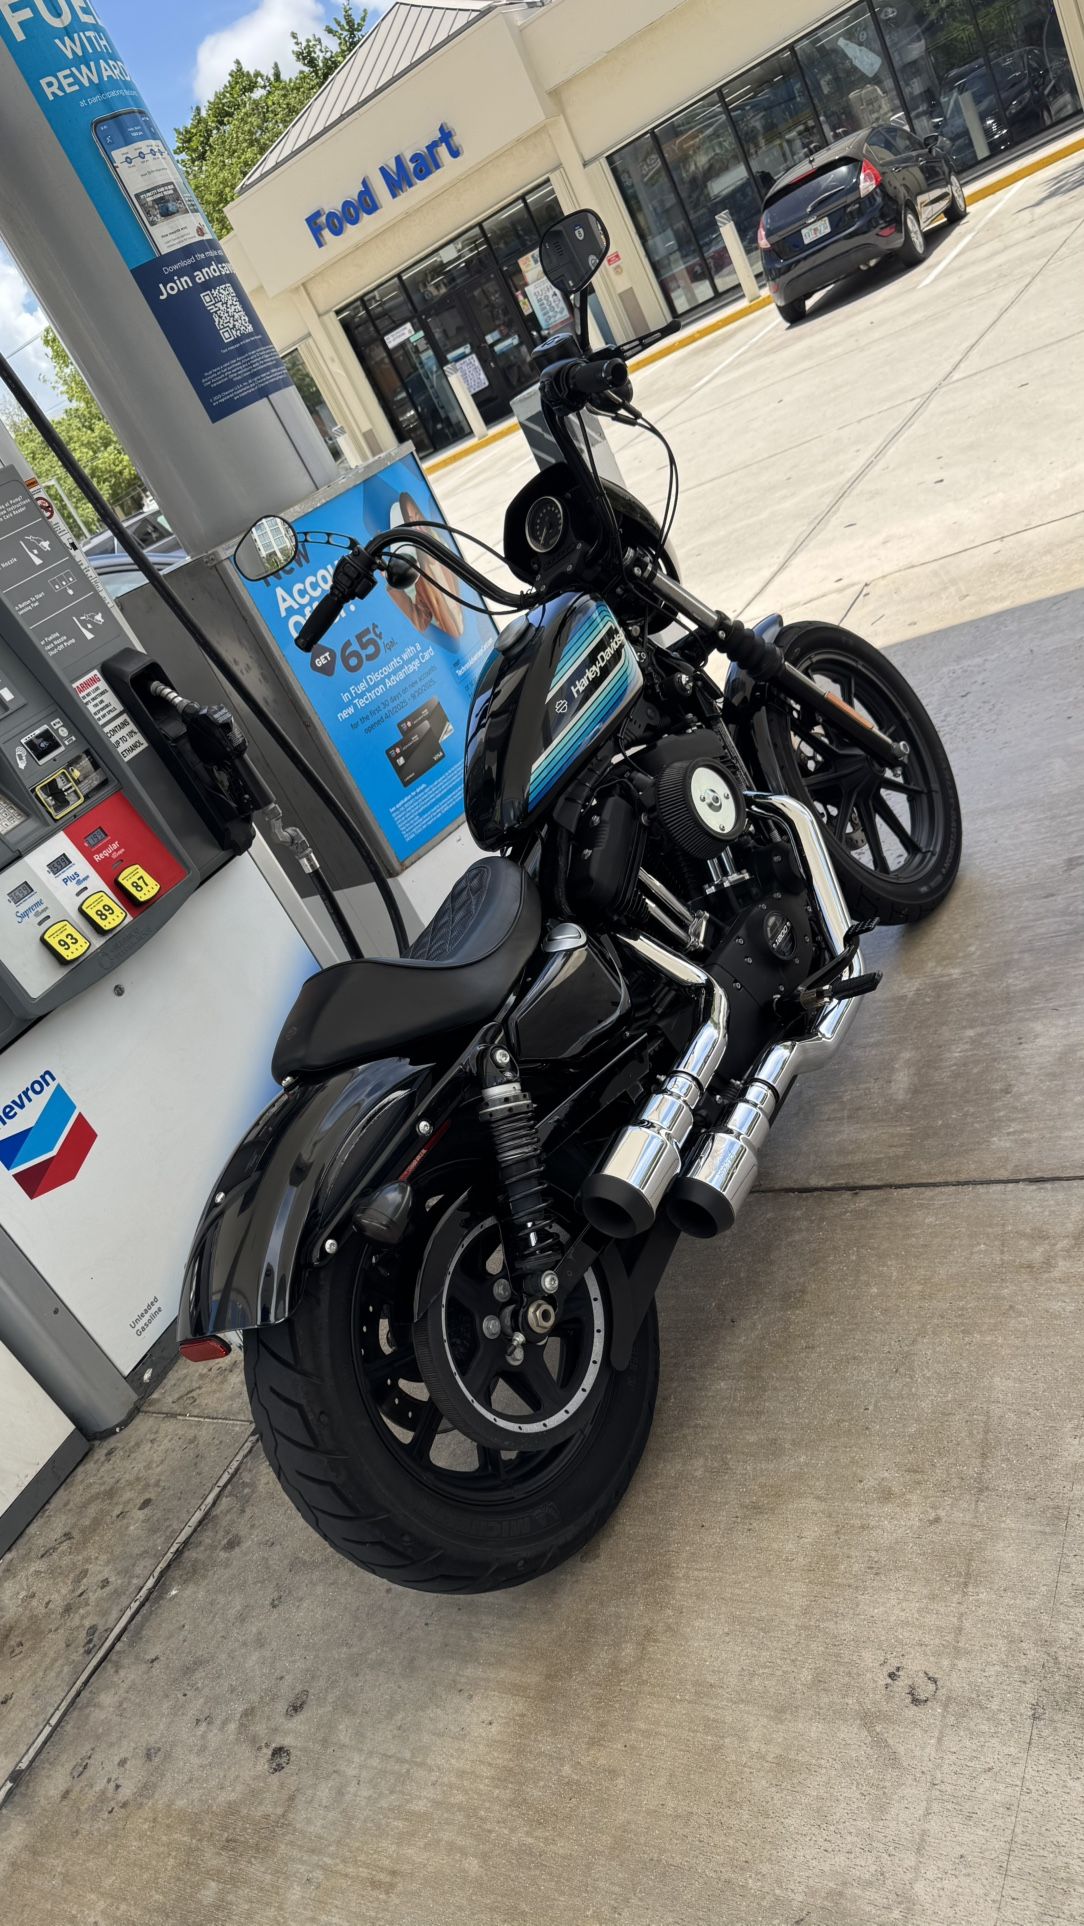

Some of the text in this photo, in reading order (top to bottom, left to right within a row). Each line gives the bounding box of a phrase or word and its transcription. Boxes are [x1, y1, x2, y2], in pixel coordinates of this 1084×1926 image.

[0, 0, 100, 42] FUE
[54, 31, 112, 60] WITH
[305, 122, 462, 249] Food Mart
[162, 255, 196, 275] Download
[195, 252, 206, 261] the
[158, 261, 237, 300] Join and sav
[275, 556, 341, 618] Acco
[44, 631, 60, 642] Fueling
[53, 635, 68, 645] Nozzle
[64, 638, 76, 647] Pump
[315, 652, 331, 668] GET
[570, 629, 625, 698] Harley-Davids
[337, 706, 355, 721] new
[353, 684, 386, 709] Techron
[385, 659, 421, 690] Advantage
[419, 645, 435, 663] Card
[340, 642, 421, 703] in Fuel Discounts with a
[350, 721, 359, 730] for
[358, 715, 370, 725] the
[368, 706, 382, 718] first
[380, 699, 390, 709] 30
[389, 691, 402, 704] days
[105, 718, 130, 739] CONTAINS
[364, 715, 385, 735] opened
[112, 728, 138, 749] UP TO 10%
[121, 740, 144, 758] ETHANOL
[93, 840, 121, 862] Regular
[62, 871, 80, 886] Plus
[131, 875, 149, 893] 87
[15, 898, 45, 923] Supreme
[95, 903, 115, 921] 89
[57, 932, 79, 951] 93
[0, 1069, 57, 1127] evron
[129, 1296, 159, 1329] Unleaded
[135, 1306, 162, 1337] Gasoline
